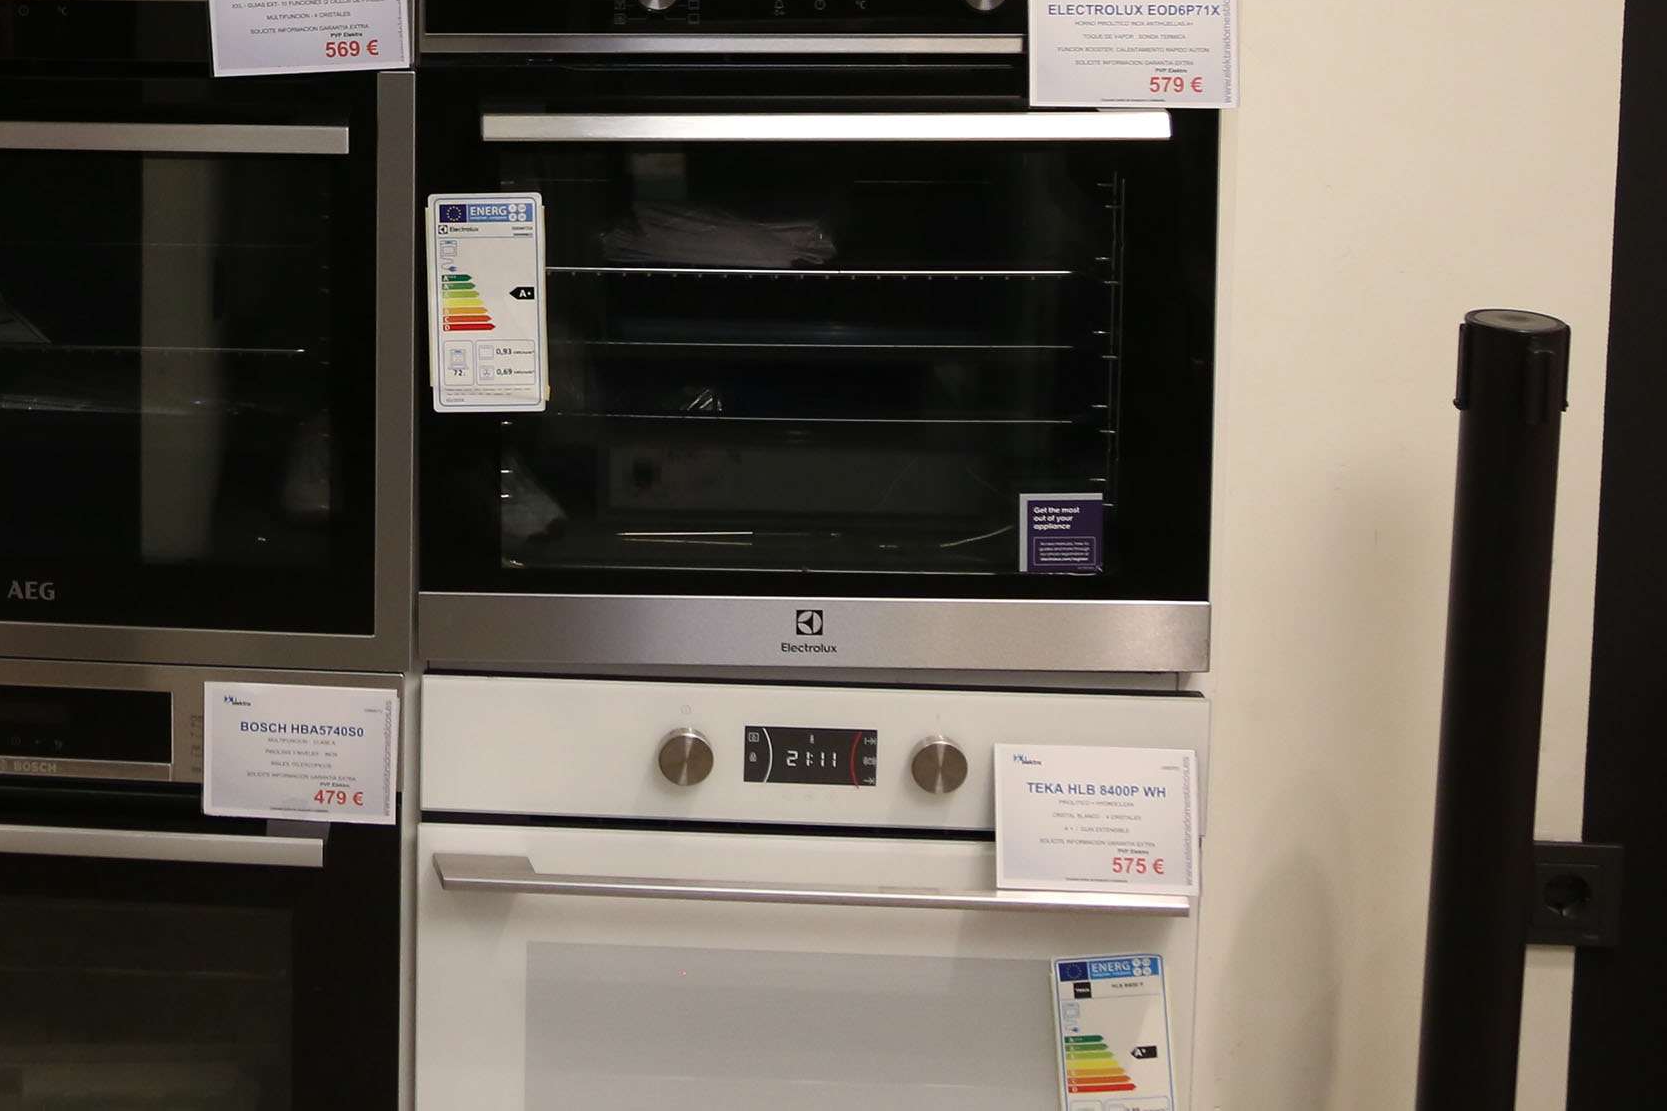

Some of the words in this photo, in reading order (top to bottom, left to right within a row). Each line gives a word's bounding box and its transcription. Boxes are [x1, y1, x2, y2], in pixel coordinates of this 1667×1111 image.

[1048, 4, 1143, 16] ELECTROLUX
[1147, 4, 1220, 16] EOD6P71X
[325, 40, 360, 58] 569
[366, 40, 379, 56] €
[1149, 77, 1184, 93] 579
[1190, 76, 1203, 93] €
[470, 206, 508, 216] ENERG
[495, 348, 512, 356] 0,93
[7, 580, 55, 601] AEG
[781, 642, 838, 653] Electrolux
[240, 721, 287, 734] BOSCH
[291, 724, 364, 737] HBA5740S0
[786, 750, 837, 767] 21:11
[14, 761, 57, 773] BOSCH
[314, 790, 347, 805] 479
[353, 791, 364, 806] €
[1026, 782, 1063, 795] TEKA
[1068, 784, 1095, 796] HLB
[1099, 785, 1140, 797] 8400P
[1143, 787, 1167, 798] WH
[1112, 857, 1147, 874] 575
[1153, 858, 1165, 875] €
[1091, 961, 1131, 973] ENERG
